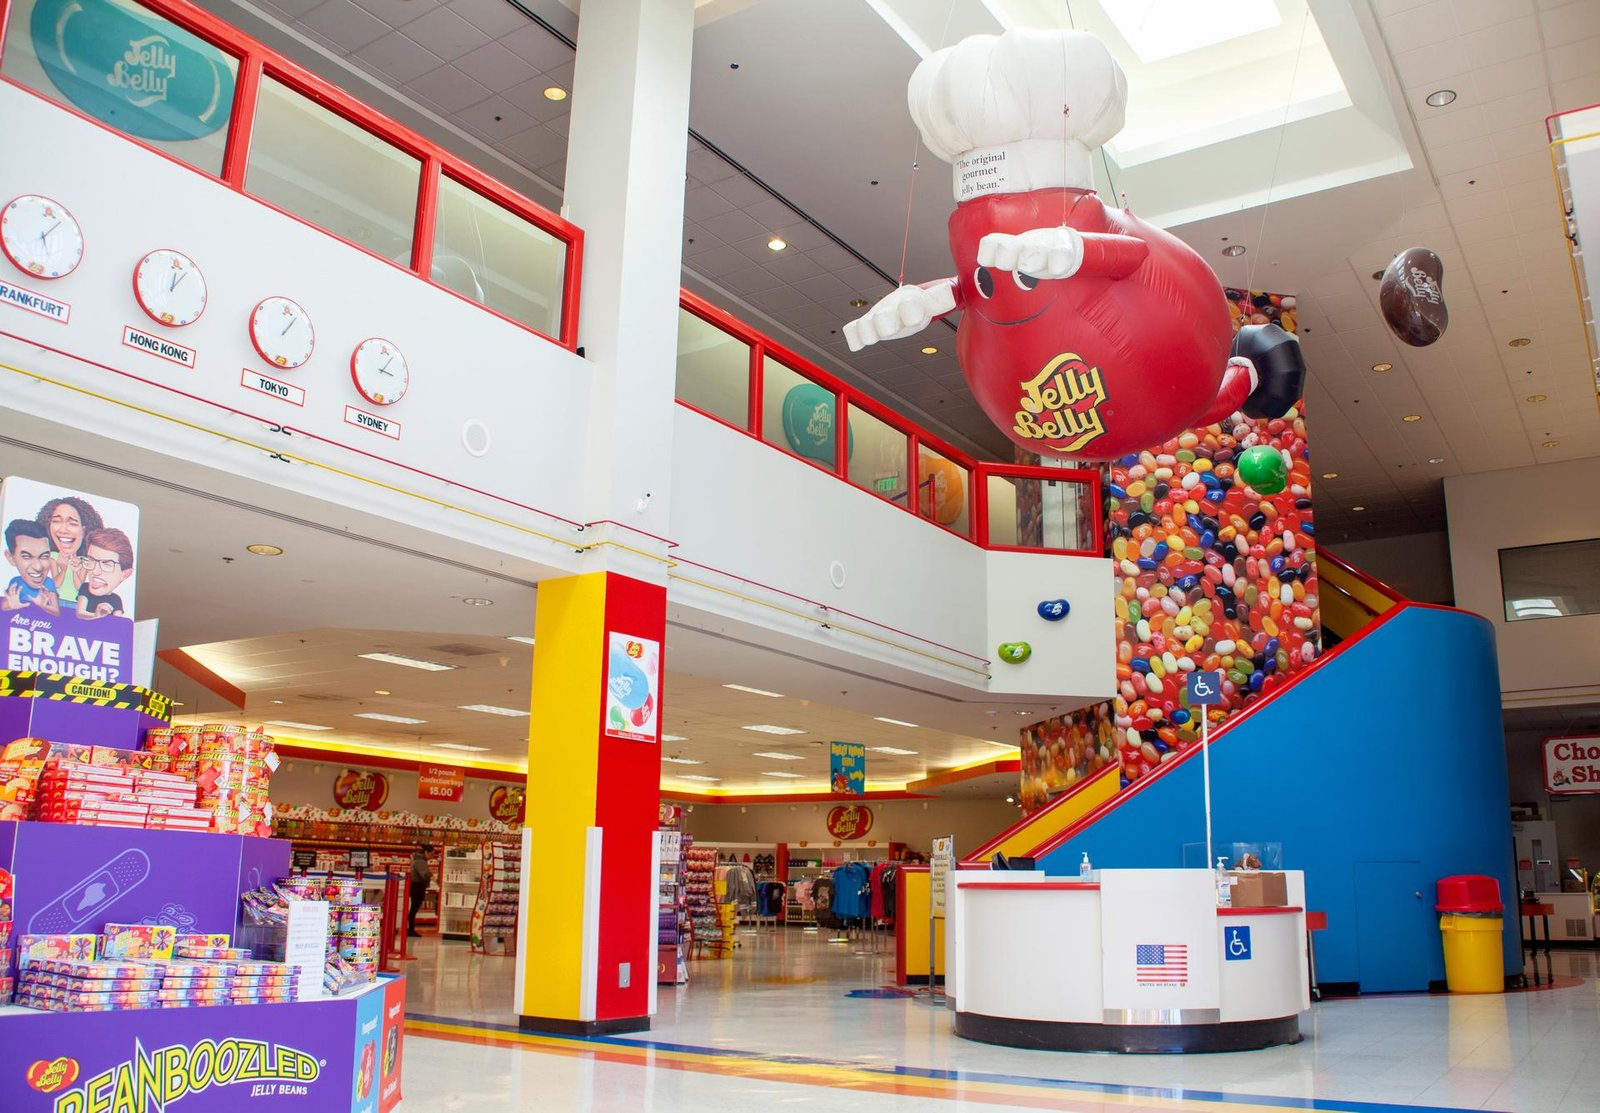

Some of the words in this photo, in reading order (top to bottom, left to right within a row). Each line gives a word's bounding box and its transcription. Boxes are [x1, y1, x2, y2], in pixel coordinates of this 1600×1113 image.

[124, 35, 176, 78] Jelly
[106, 61, 167, 107] Belly
[971, 151, 1006, 166] original
[962, 167, 998, 183] gourmet
[0, 285, 64, 317] RANKFURT
[130, 332, 159, 351] HONG
[160, 343, 188, 362] KONG
[259, 378, 289, 397] TOKYO
[1020, 352, 1108, 414] Jelly
[357, 413, 389, 432] SYDNEY
[1012, 405, 1107, 453] Belly
[11, 613, 30, 625] Are
[29, 619, 52, 631] you
[9, 627, 120, 667] BRAVE
[8, 653, 120, 683] ENOUGH?
[71, 685, 111, 699] CAUTION!
[1553, 742, 1600, 761] Cho
[1571, 765, 1600, 783] Sh
[430, 786, 453, 797] $5.00
[45, 1057, 69, 1074] Jelly
[35, 1071, 63, 1093] Belly
[251, 1084, 277, 1097] JELLY
[279, 1085, 308, 1096] BEANS
